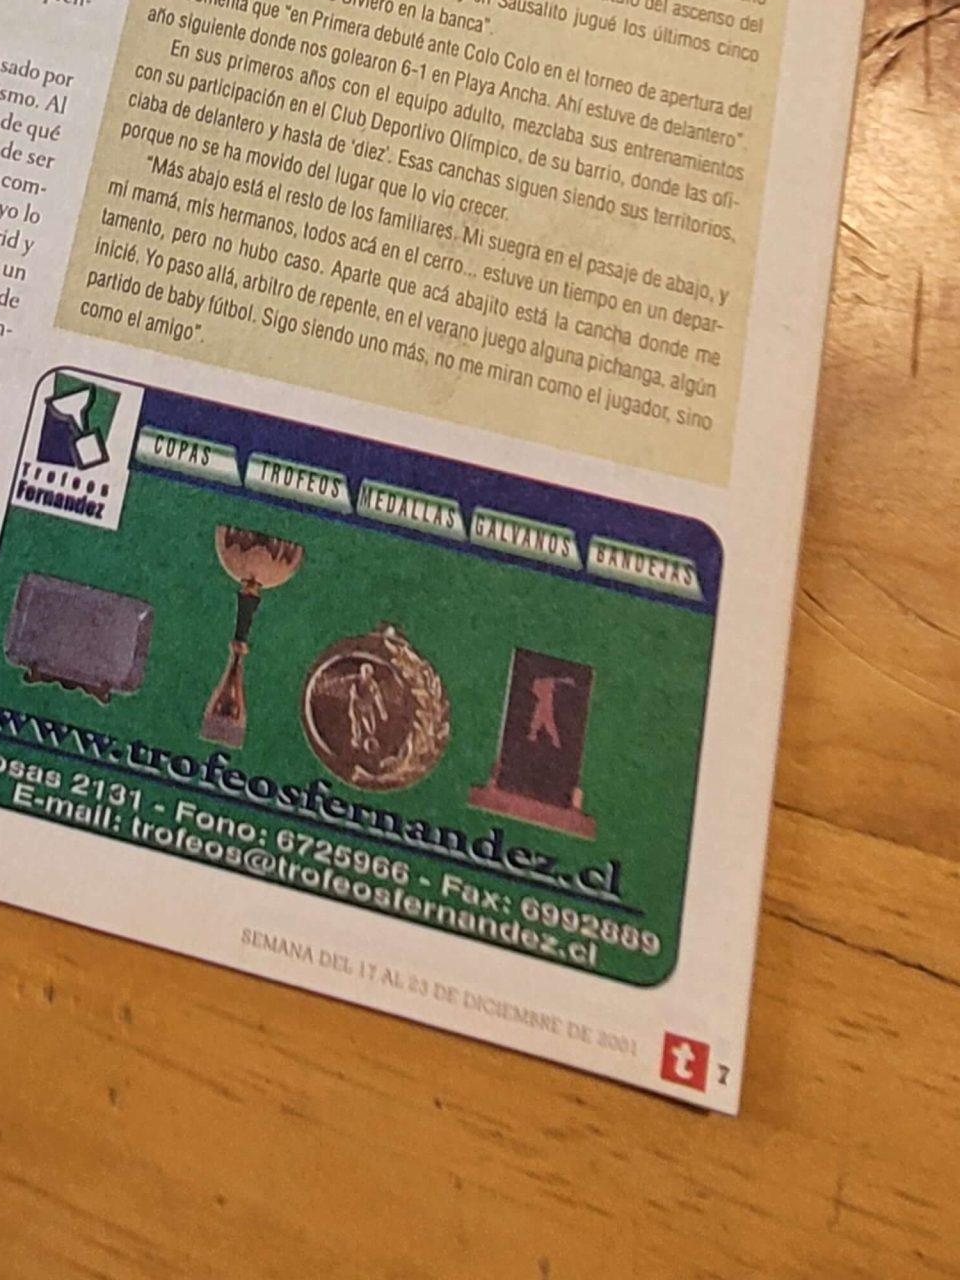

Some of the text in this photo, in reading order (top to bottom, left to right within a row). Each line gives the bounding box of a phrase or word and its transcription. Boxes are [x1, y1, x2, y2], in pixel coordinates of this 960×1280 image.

[100, 206, 722, 368] tamento, pero no hubo caso. Aparte que acá abajito está la cancha donde me
[153, 433, 212, 467] COPAS
[16, 480, 106, 520] Fernandez
[258, 460, 342, 499] TROFEOS
[359, 486, 456, 530] MEDALLAS
[474, 514, 572, 558] GALVANOS
[596, 543, 695, 587] BANDEJAS
[12, 781, 598, 967] E-mail: trofeos@trofeosfernandez.cl
[69, 772, 142, 812] 2131
[174, 799, 268, 847] Fono:
[275, 828, 410, 886] 6725966
[440, 872, 512, 916] Fax:
[520, 897, 661, 957] 6992889
[239, 927, 638, 1058] SEMANA DEL 17 AL 23 DE DICIEMBRE DE 2001
[717, 1063, 731, 1086] 7
